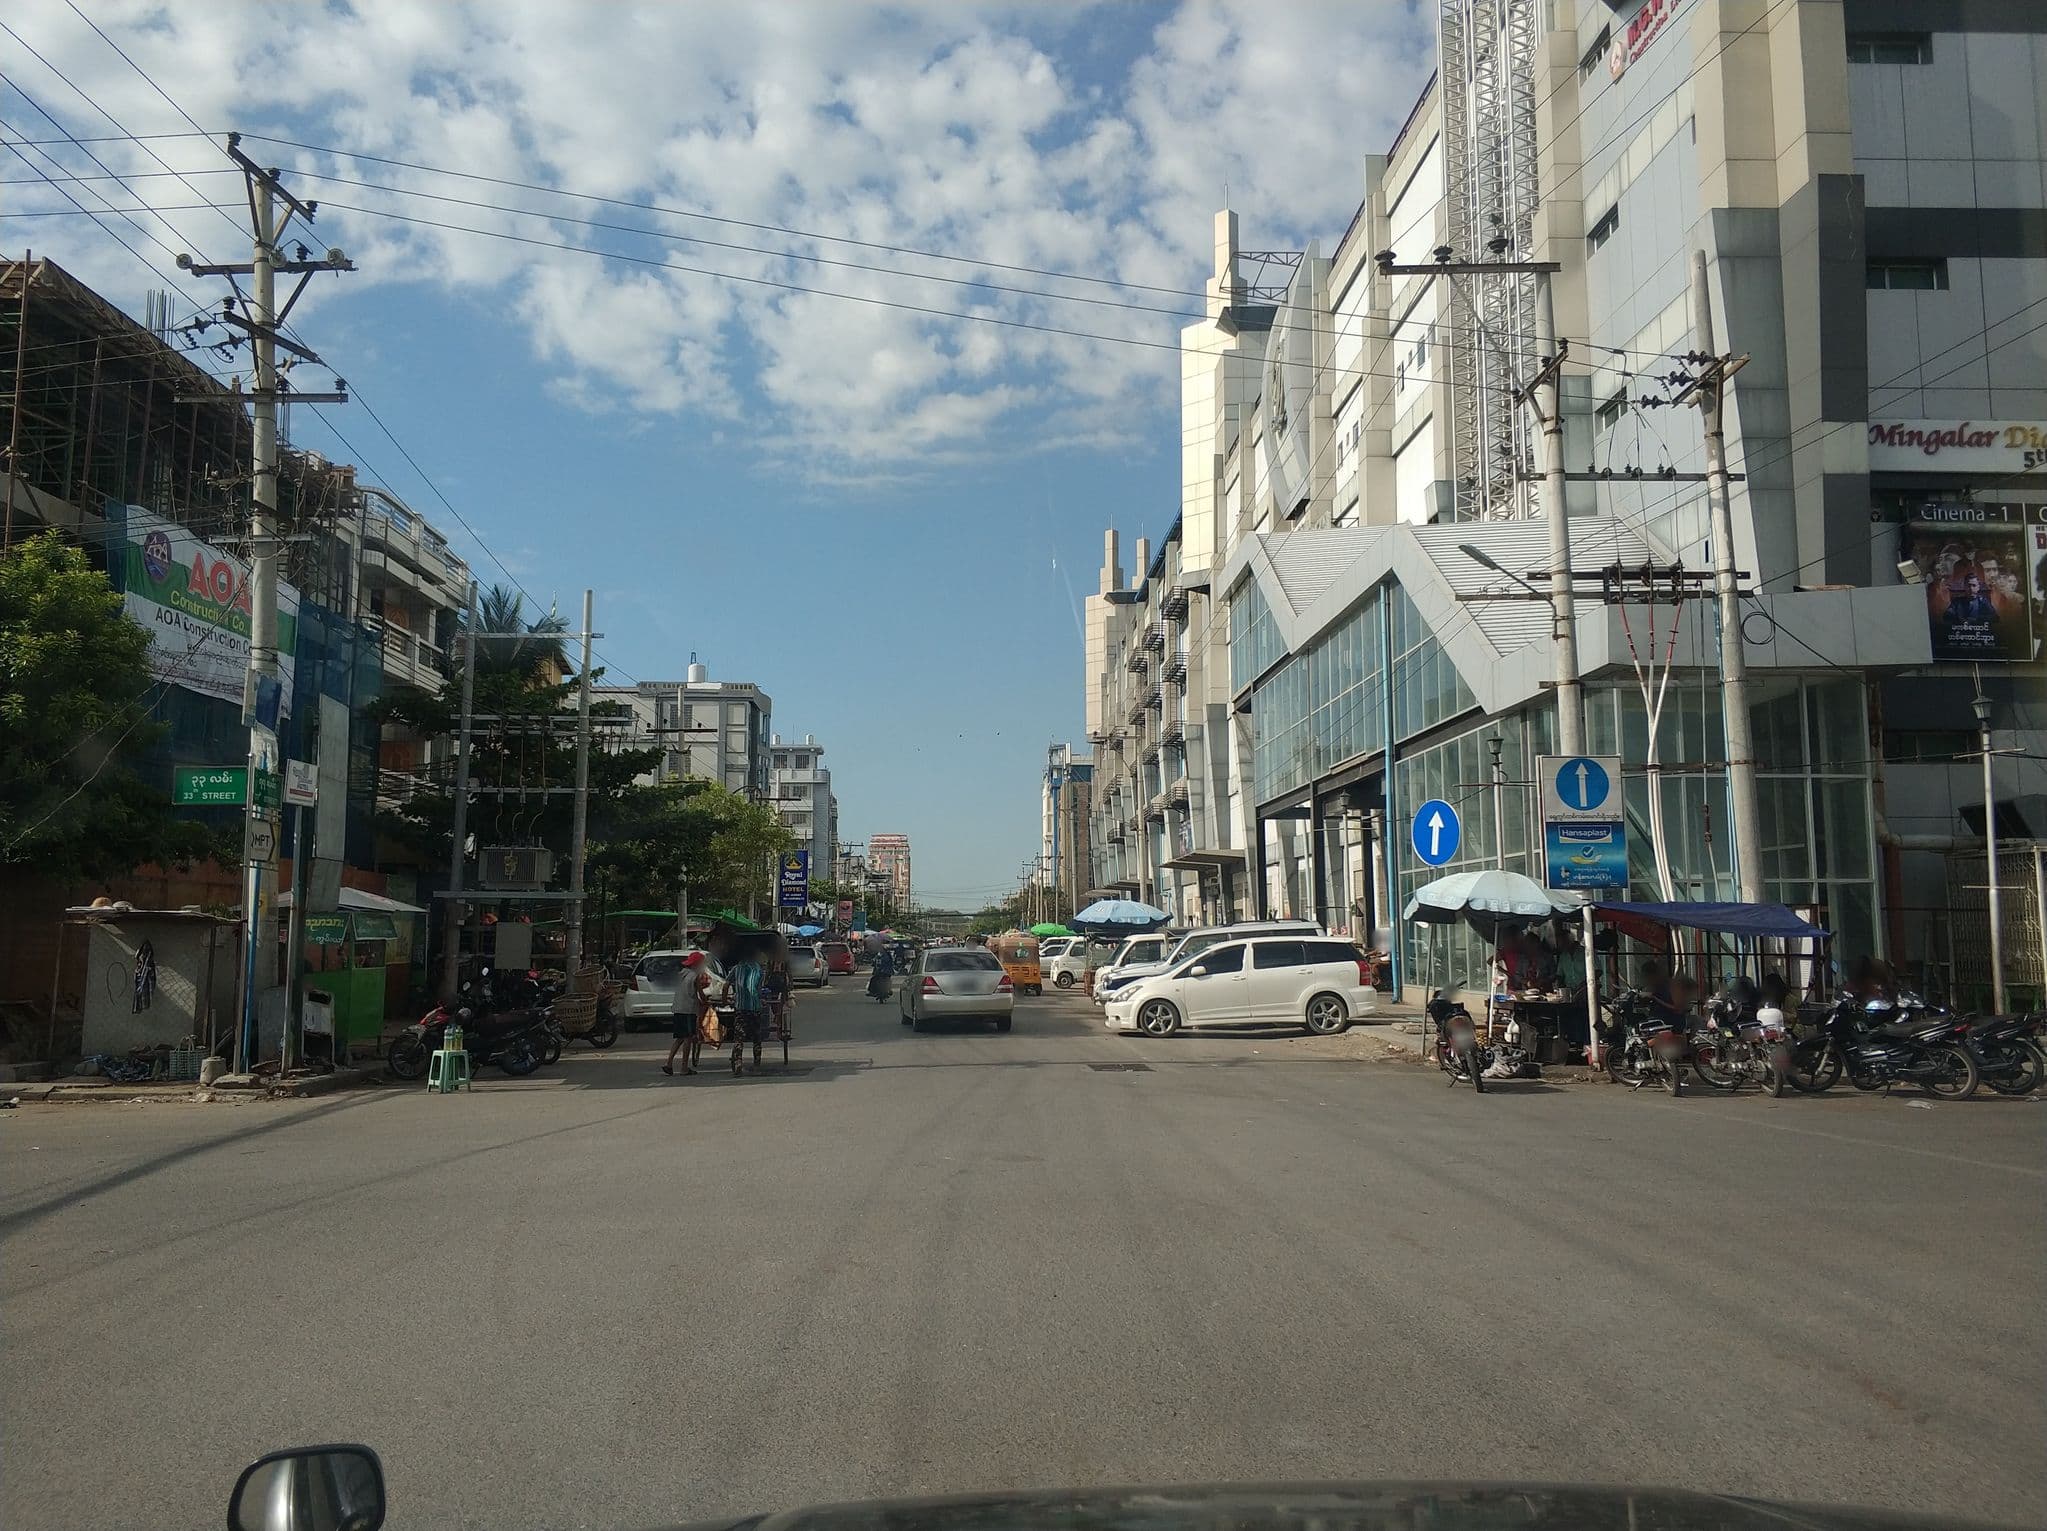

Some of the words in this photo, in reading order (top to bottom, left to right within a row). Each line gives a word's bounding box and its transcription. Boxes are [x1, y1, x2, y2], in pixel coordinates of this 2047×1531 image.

[1869, 421, 1999, 456] Mingalar
[1920, 503, 1985, 522] Cinema
[2001, 506, 2009, 522] 1
[188, 552, 253, 618] AOA
[170, 590, 229, 623] Constructin
[155, 607, 182, 630] AOA
[191, 775, 207, 788] ၃၃
[209, 770, 233, 784] လမ်း
[201, 791, 237, 800] STREET
[254, 833, 271, 847] MPT
[1561, 828, 1607, 837] Hansaplast
[784, 872, 802, 880] Royal
